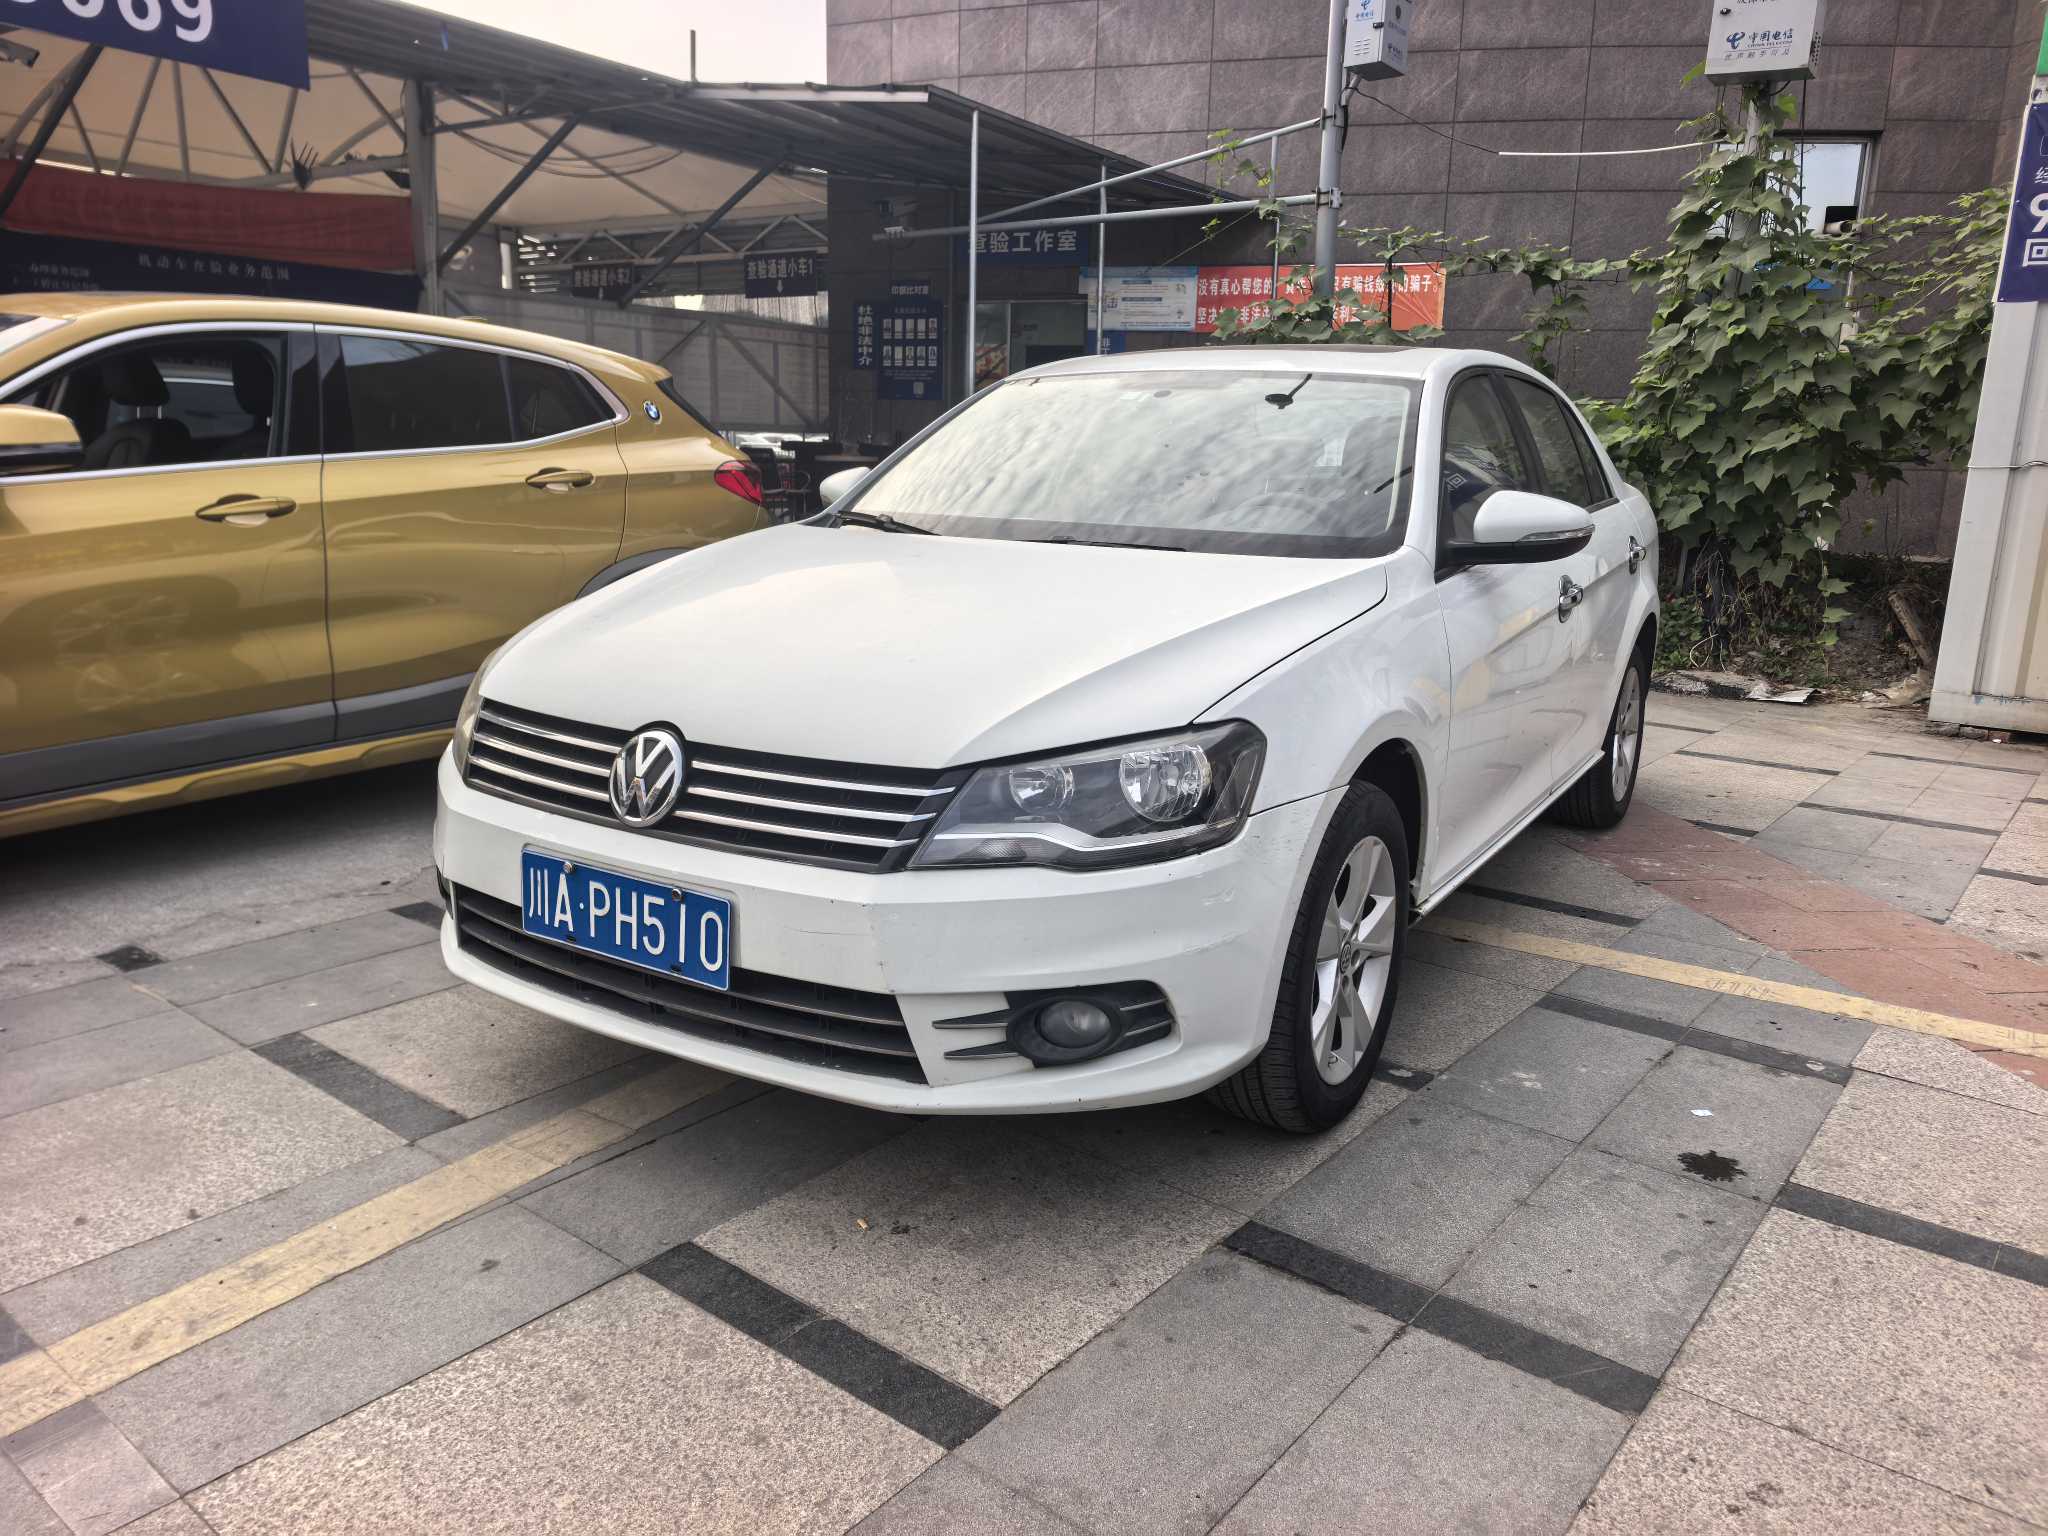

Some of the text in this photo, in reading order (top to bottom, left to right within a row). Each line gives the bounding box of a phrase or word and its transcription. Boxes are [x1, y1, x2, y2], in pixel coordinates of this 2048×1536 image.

[1748, 29, 1793, 42] 中国电信
[968, 230, 1077, 253] 查验工作室
